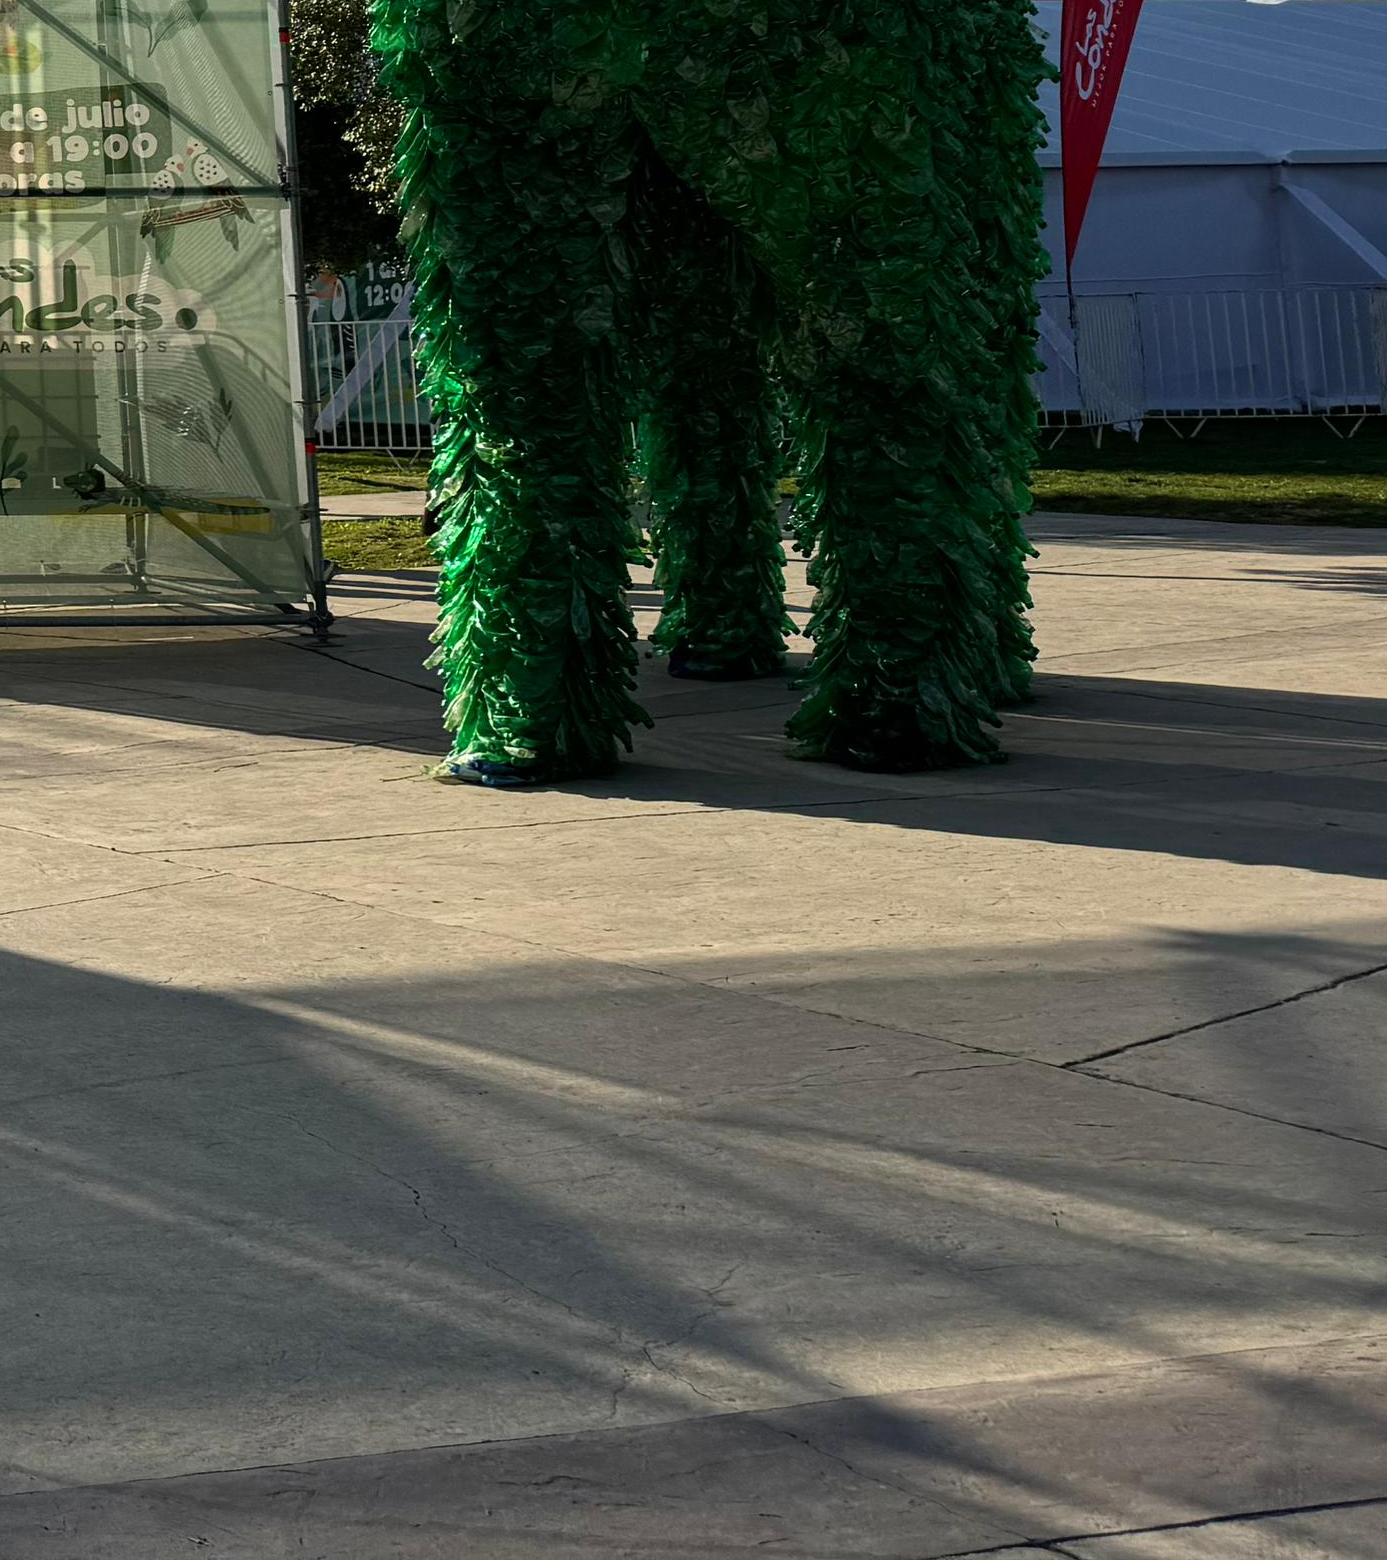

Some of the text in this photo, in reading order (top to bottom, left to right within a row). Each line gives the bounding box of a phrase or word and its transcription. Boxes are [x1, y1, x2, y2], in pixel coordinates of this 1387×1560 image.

[0, 103, 48, 131] de
[62, 98, 150, 134] julio
[10, 141, 35, 164] a
[46, 132, 158, 163] 19:00
[73, 339, 168, 354] TODOS
